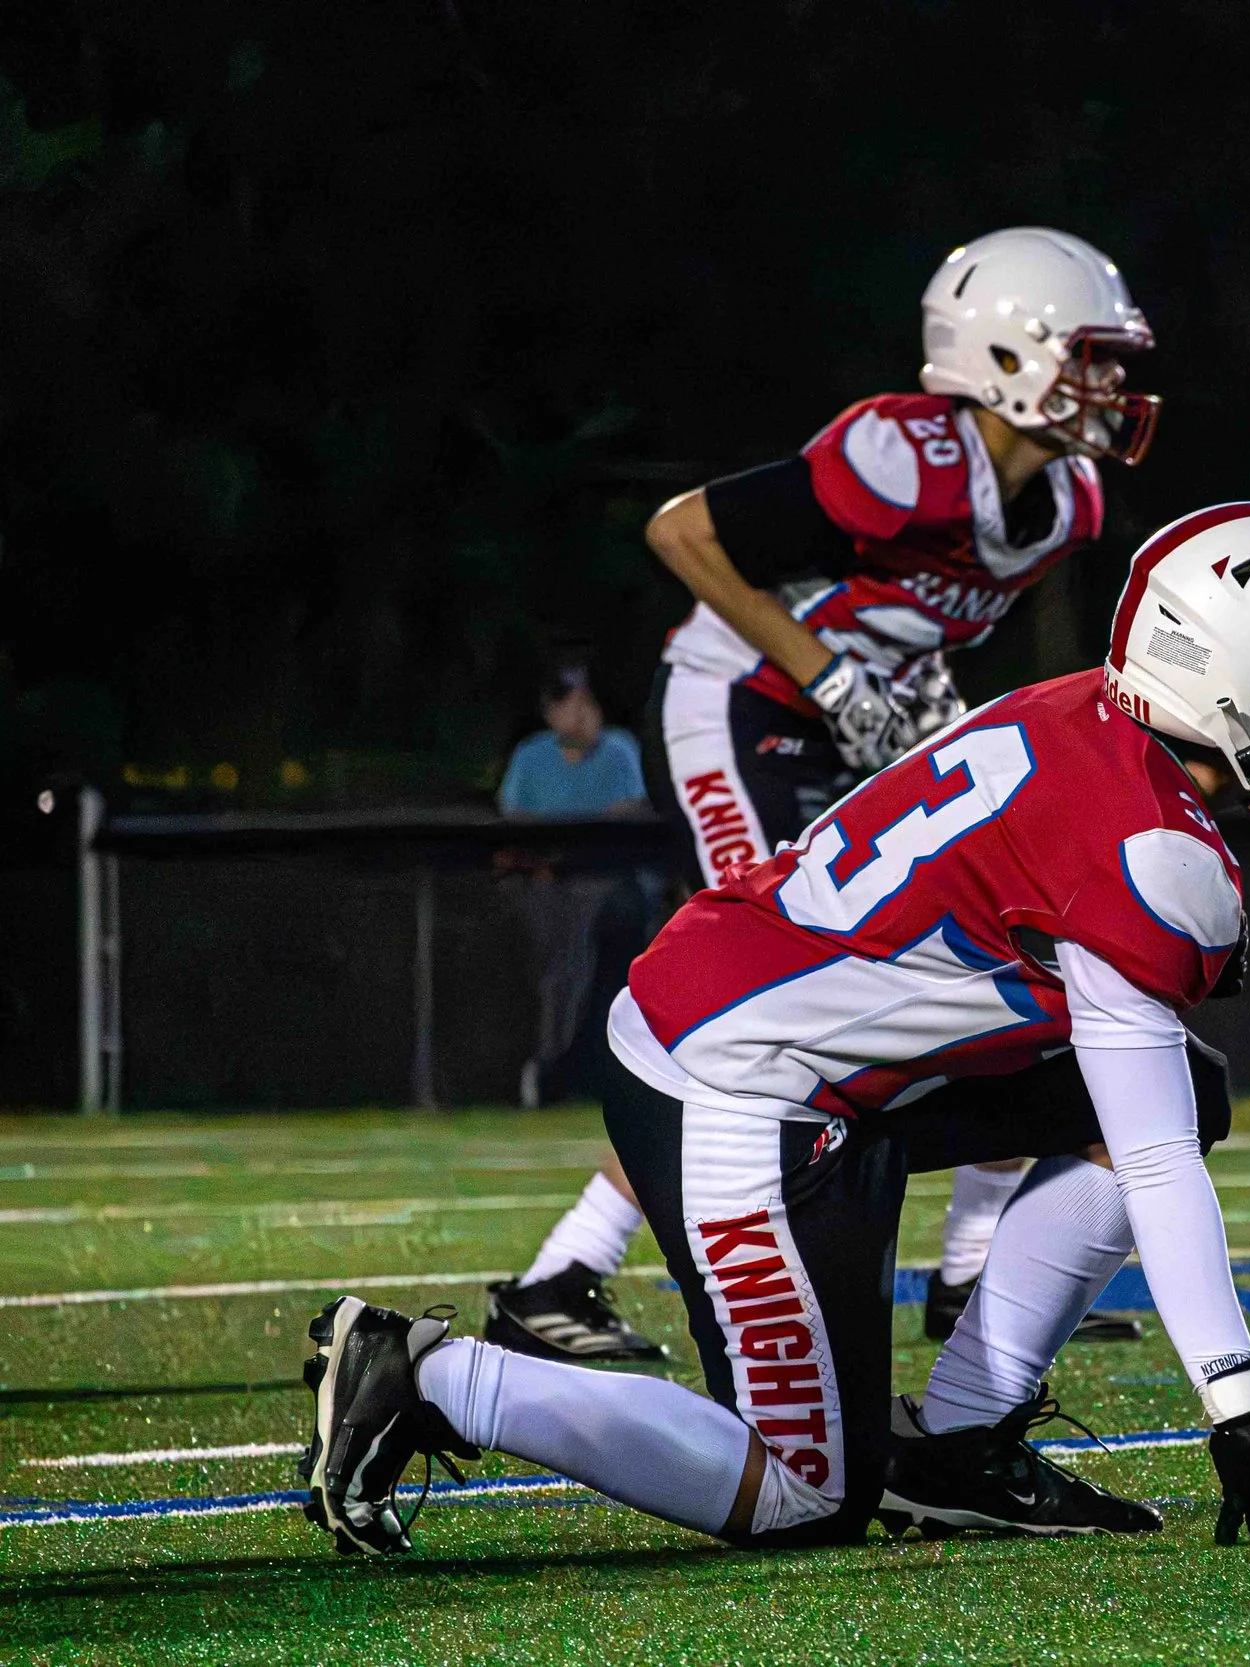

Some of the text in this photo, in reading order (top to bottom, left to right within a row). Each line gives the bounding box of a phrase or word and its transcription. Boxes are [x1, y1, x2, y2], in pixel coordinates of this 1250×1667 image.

[903, 414, 961, 467] 20
[684, 769, 756, 887] KNIG
[697, 1209, 830, 1488] KNIGHTS
[1200, 1354, 1240, 1377] NXTRND
